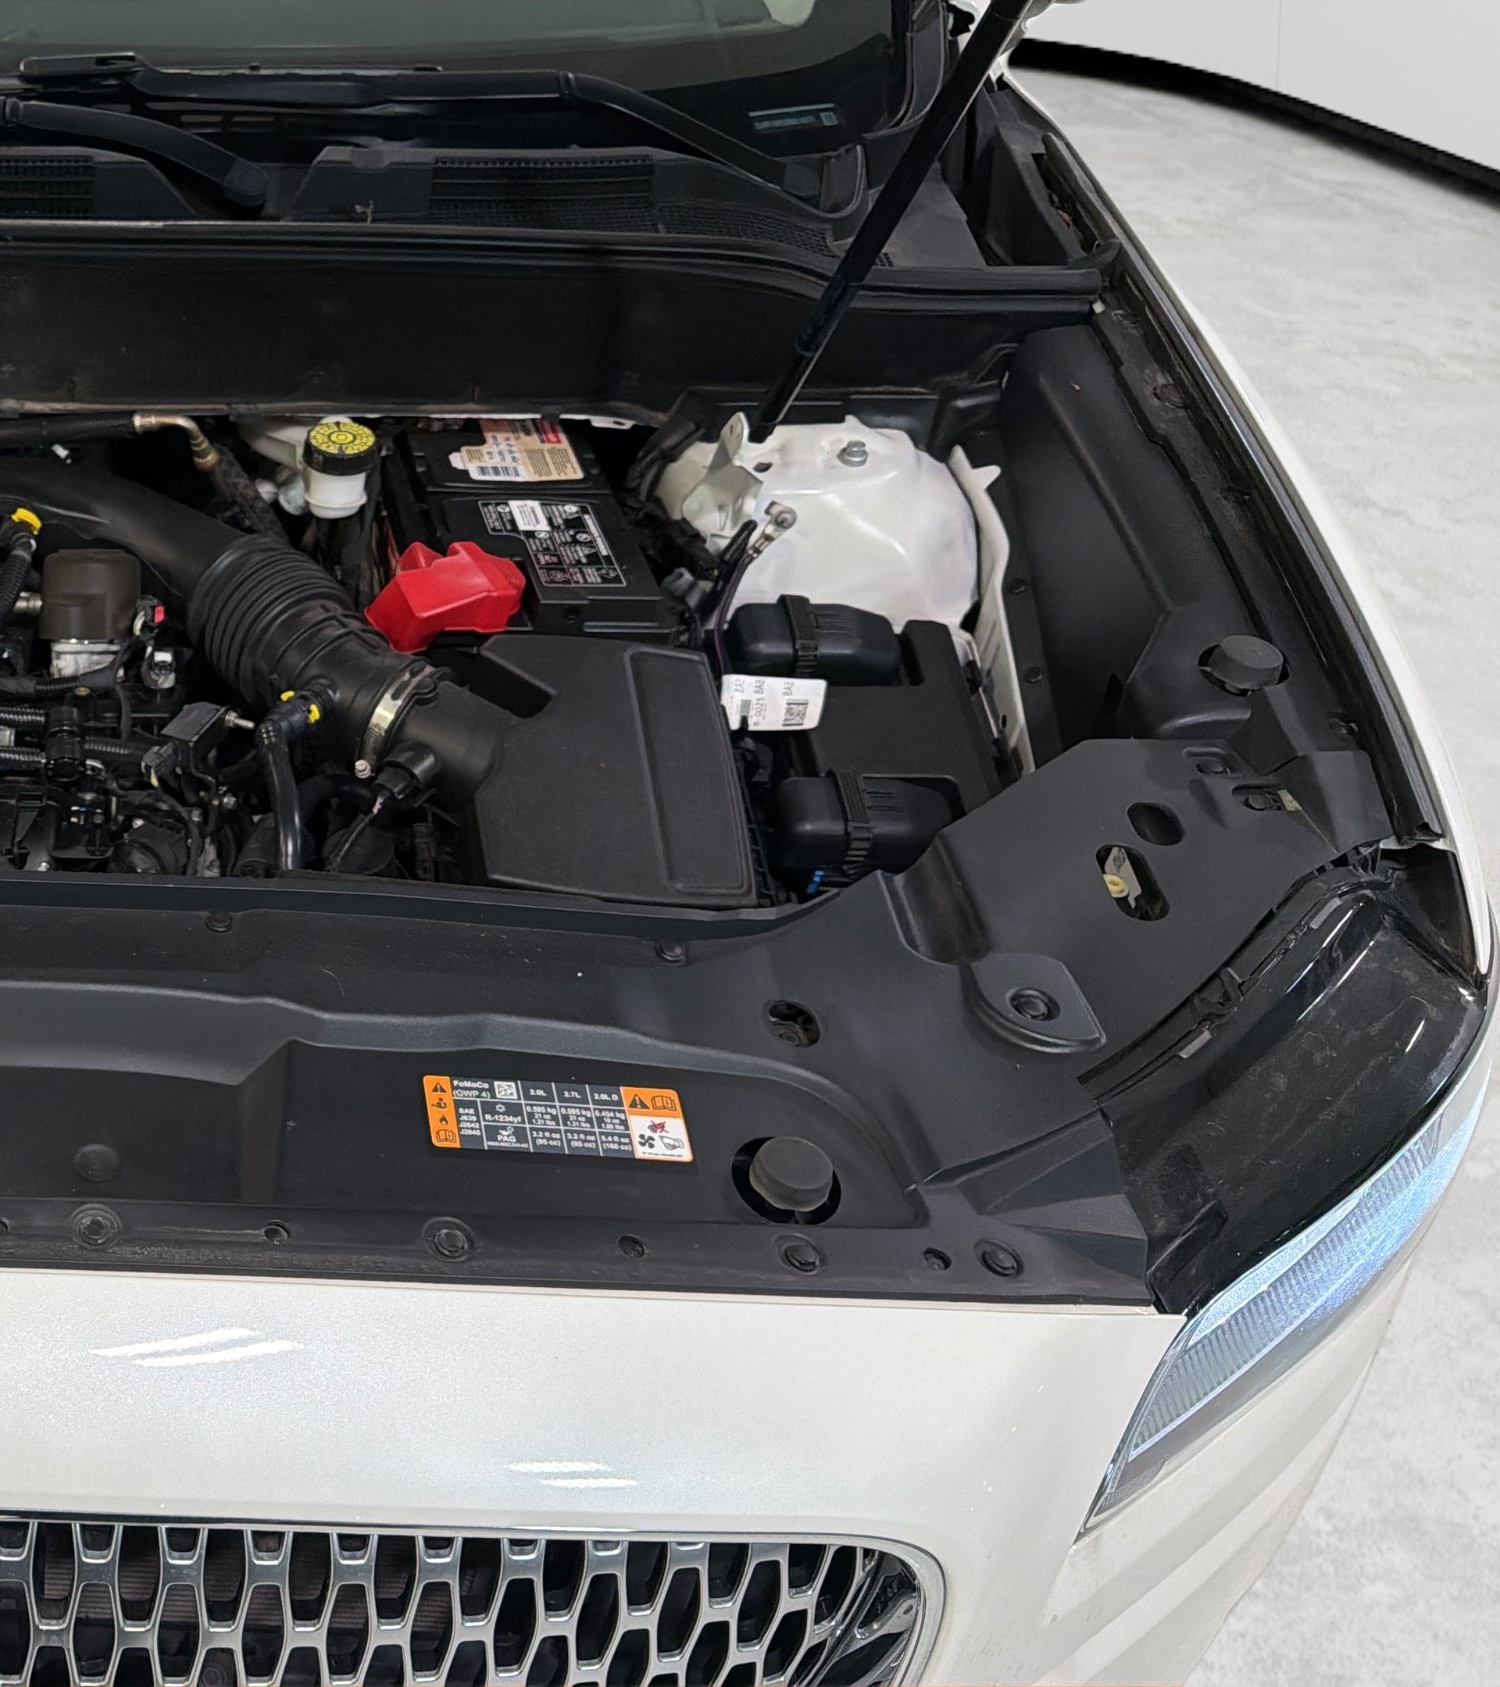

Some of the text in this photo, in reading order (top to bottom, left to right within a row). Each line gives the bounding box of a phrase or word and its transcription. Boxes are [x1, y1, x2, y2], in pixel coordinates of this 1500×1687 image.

[453, 1080, 489, 1089] FoMoCo
[453, 1089, 490, 1099] (GWP 4)
[547, 1107, 557, 1115] kg
[581, 1109, 591, 1117] kg
[485, 1114, 522, 1124] R-1234yf
[616, 1111, 625, 1120] kg
[497, 1135, 517, 1143] PAG
[549, 1139, 561, 1147] cc)
[584, 1141, 596, 1149] cc)
[620, 1143, 632, 1151] cc)
